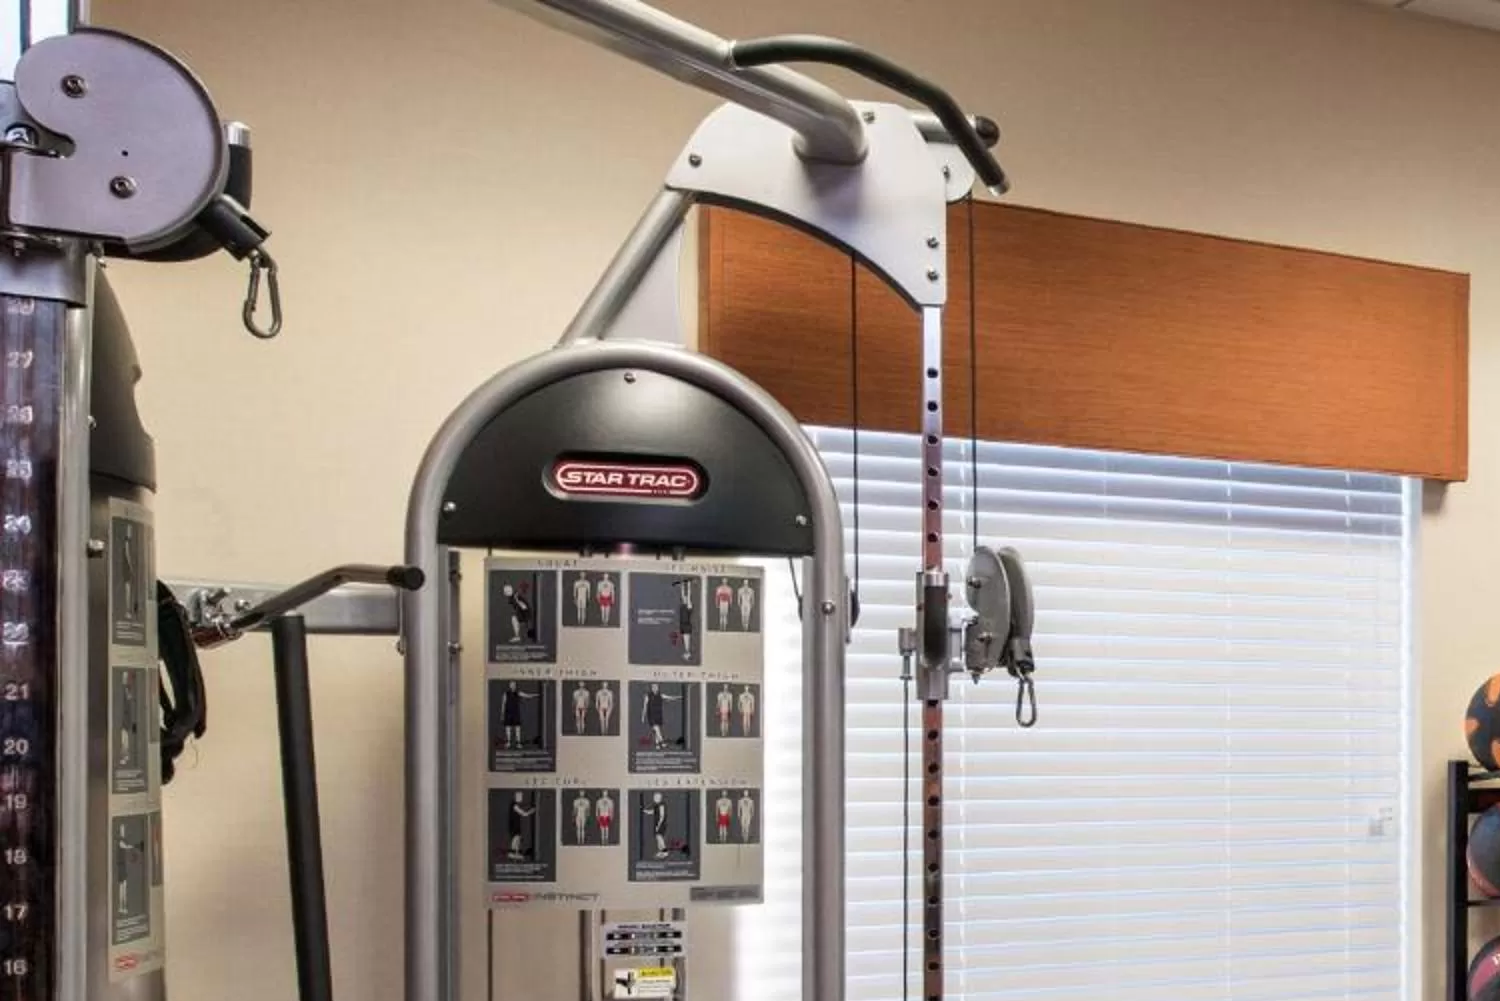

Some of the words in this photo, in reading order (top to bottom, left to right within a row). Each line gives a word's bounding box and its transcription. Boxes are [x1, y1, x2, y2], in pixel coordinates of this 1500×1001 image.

[562, 470, 624, 486] STAR
[627, 473, 688, 488] TRAC
[5, 683, 29, 700] 21
[4, 738, 29, 755] 20
[6, 793, 27, 809] 19
[5, 848, 27, 864] 18
[4, 904, 27, 920] 17
[4, 959, 27, 975] 16
